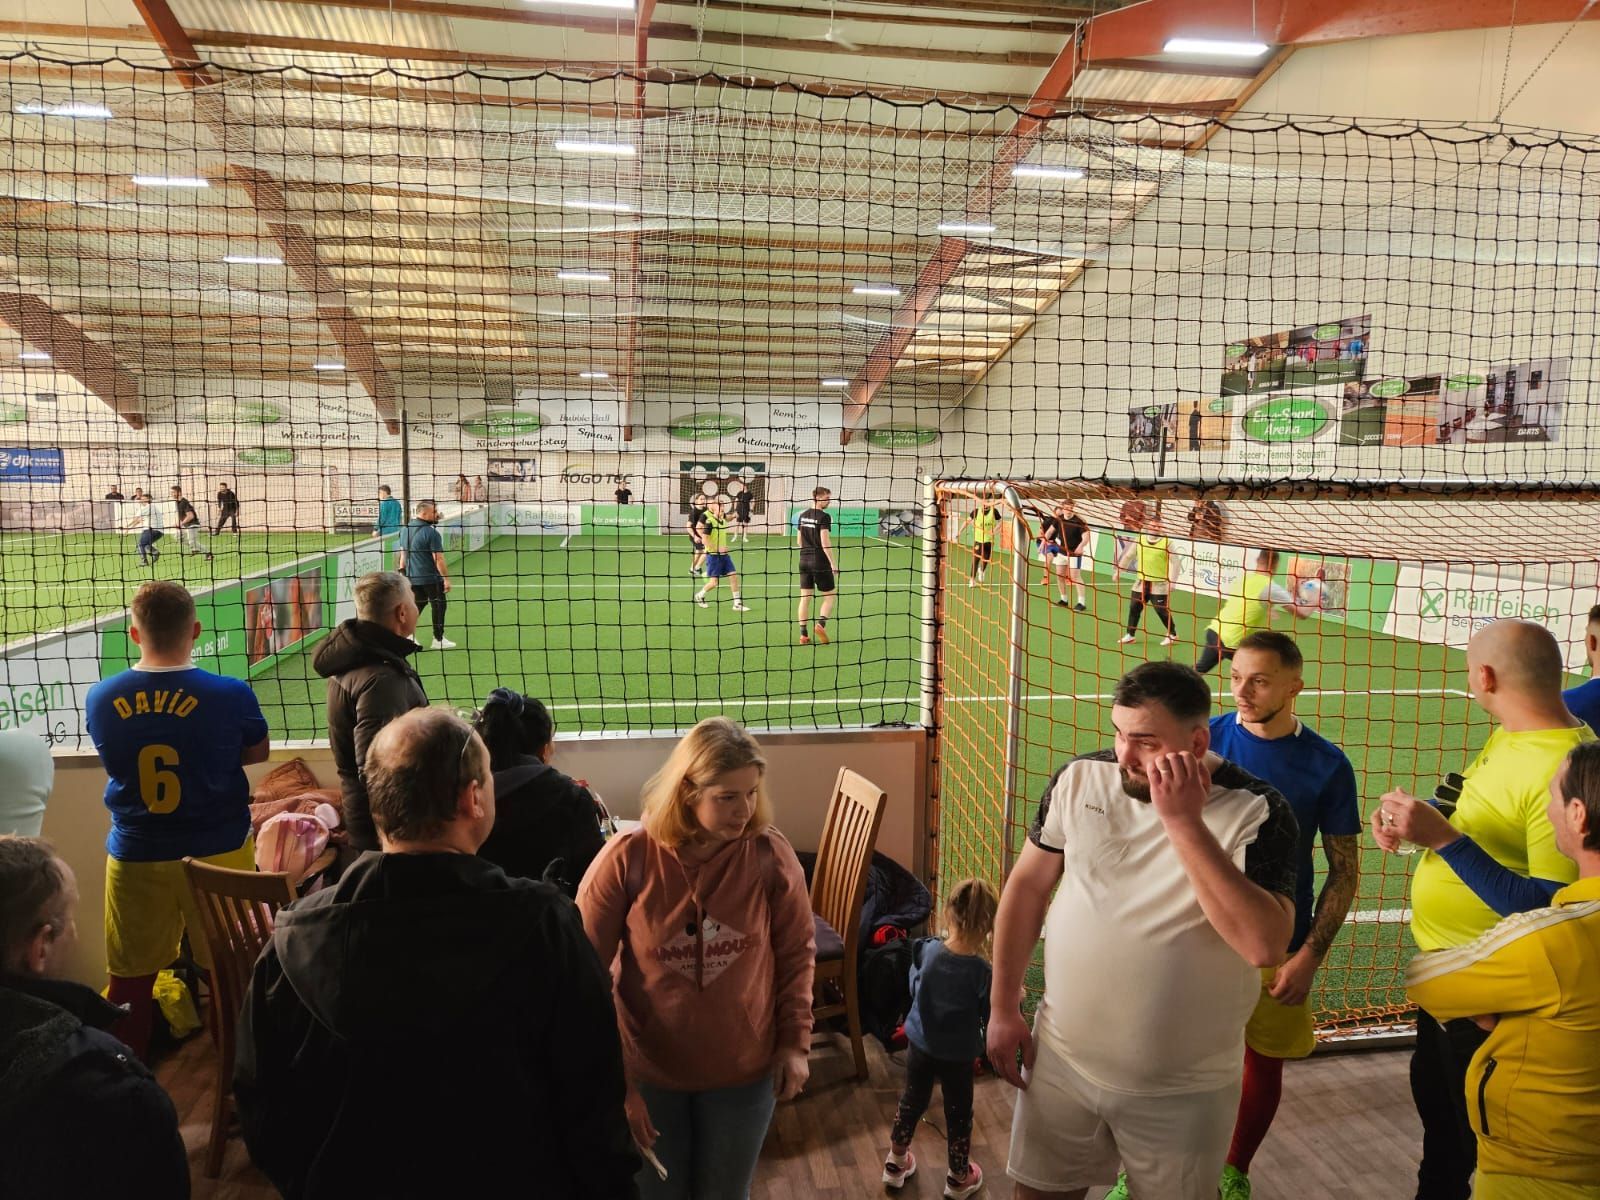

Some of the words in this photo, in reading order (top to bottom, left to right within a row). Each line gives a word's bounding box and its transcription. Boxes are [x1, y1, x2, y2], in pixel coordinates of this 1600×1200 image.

[281, 430, 361, 443] Wintergarten
[412, 425, 445, 440] Tennis
[577, 427, 614, 442] Squash
[1263, 423, 1302, 436] Arena
[1516, 427, 1541, 436] DARTS
[475, 438, 568, 449] Kindergeburtstag
[736, 436, 801, 451] Outdoorplatz
[137, 744, 182, 815] 6
